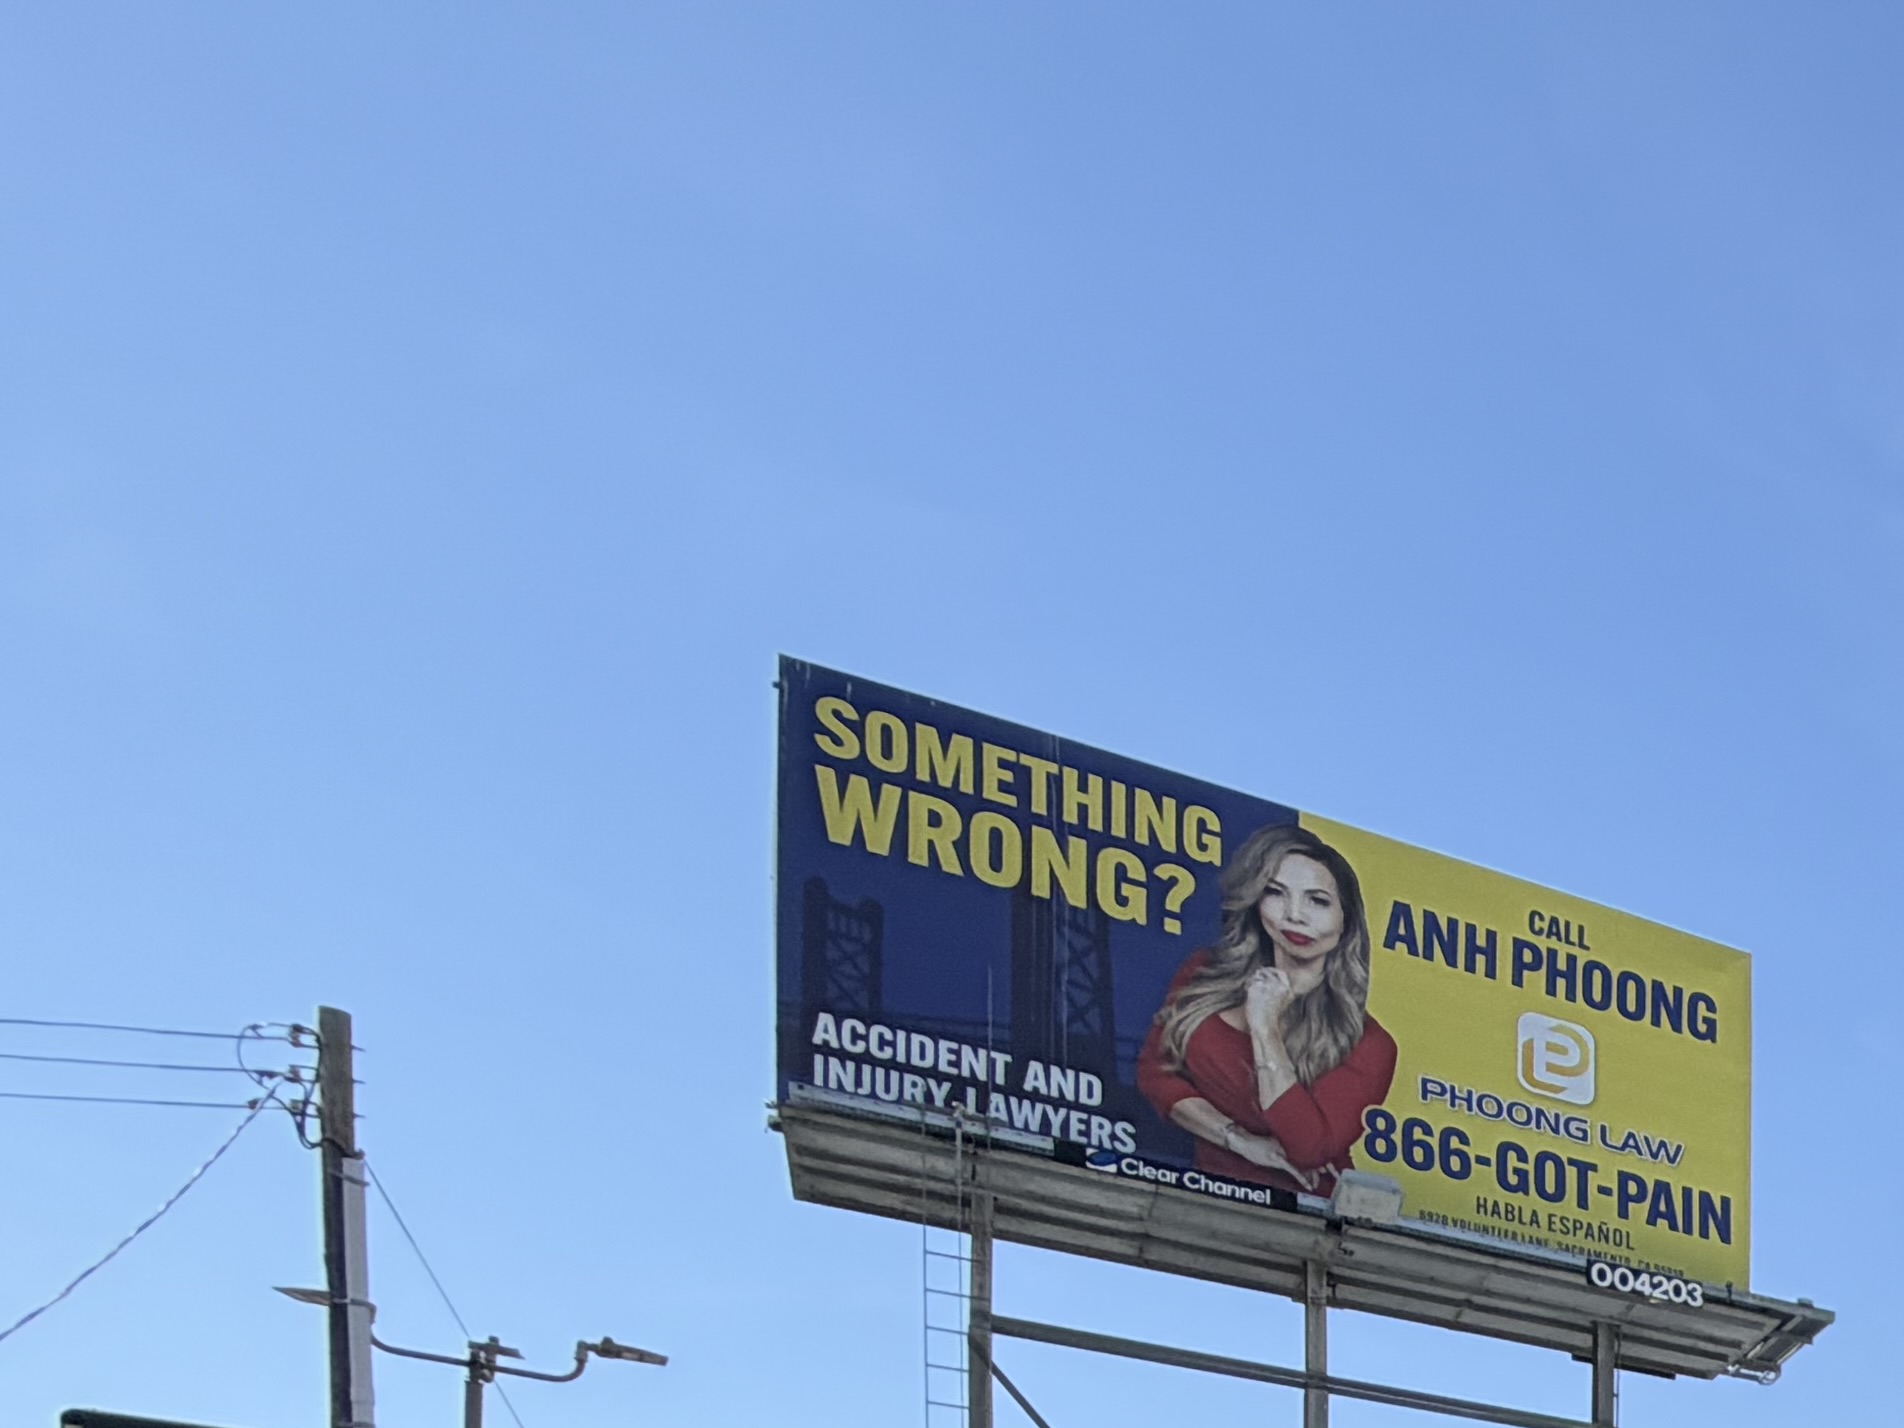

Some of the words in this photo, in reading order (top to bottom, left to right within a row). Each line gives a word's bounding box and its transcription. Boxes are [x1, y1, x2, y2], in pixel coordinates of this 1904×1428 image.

[813, 696, 1222, 866] SOMETHING
[814, 764, 1197, 934] WRONG?
[1382, 899, 1497, 980] ANH
[1511, 935, 1719, 1044] PHOONG
[1528, 909, 1591, 951] CALL
[812, 1012, 1012, 1086] ACCIDENT
[1023, 1060, 1103, 1107] AND
[813, 1054, 952, 1108] INJURY
[966, 1087, 1136, 1154] LAWYERS
[1418, 1076, 1590, 1143] PHOONG
[1600, 1123, 1685, 1165] LAW
[1121, 1157, 1180, 1185] Clear
[1183, 1171, 1271, 1205] Channel
[1364, 1108, 1733, 1246] 866-GOT-PAIN
[1476, 1196, 1541, 1229] HABLA
[1547, 1213, 1635, 1250] ESPAÑOL
[1590, 1262, 1703, 1307] 004203
